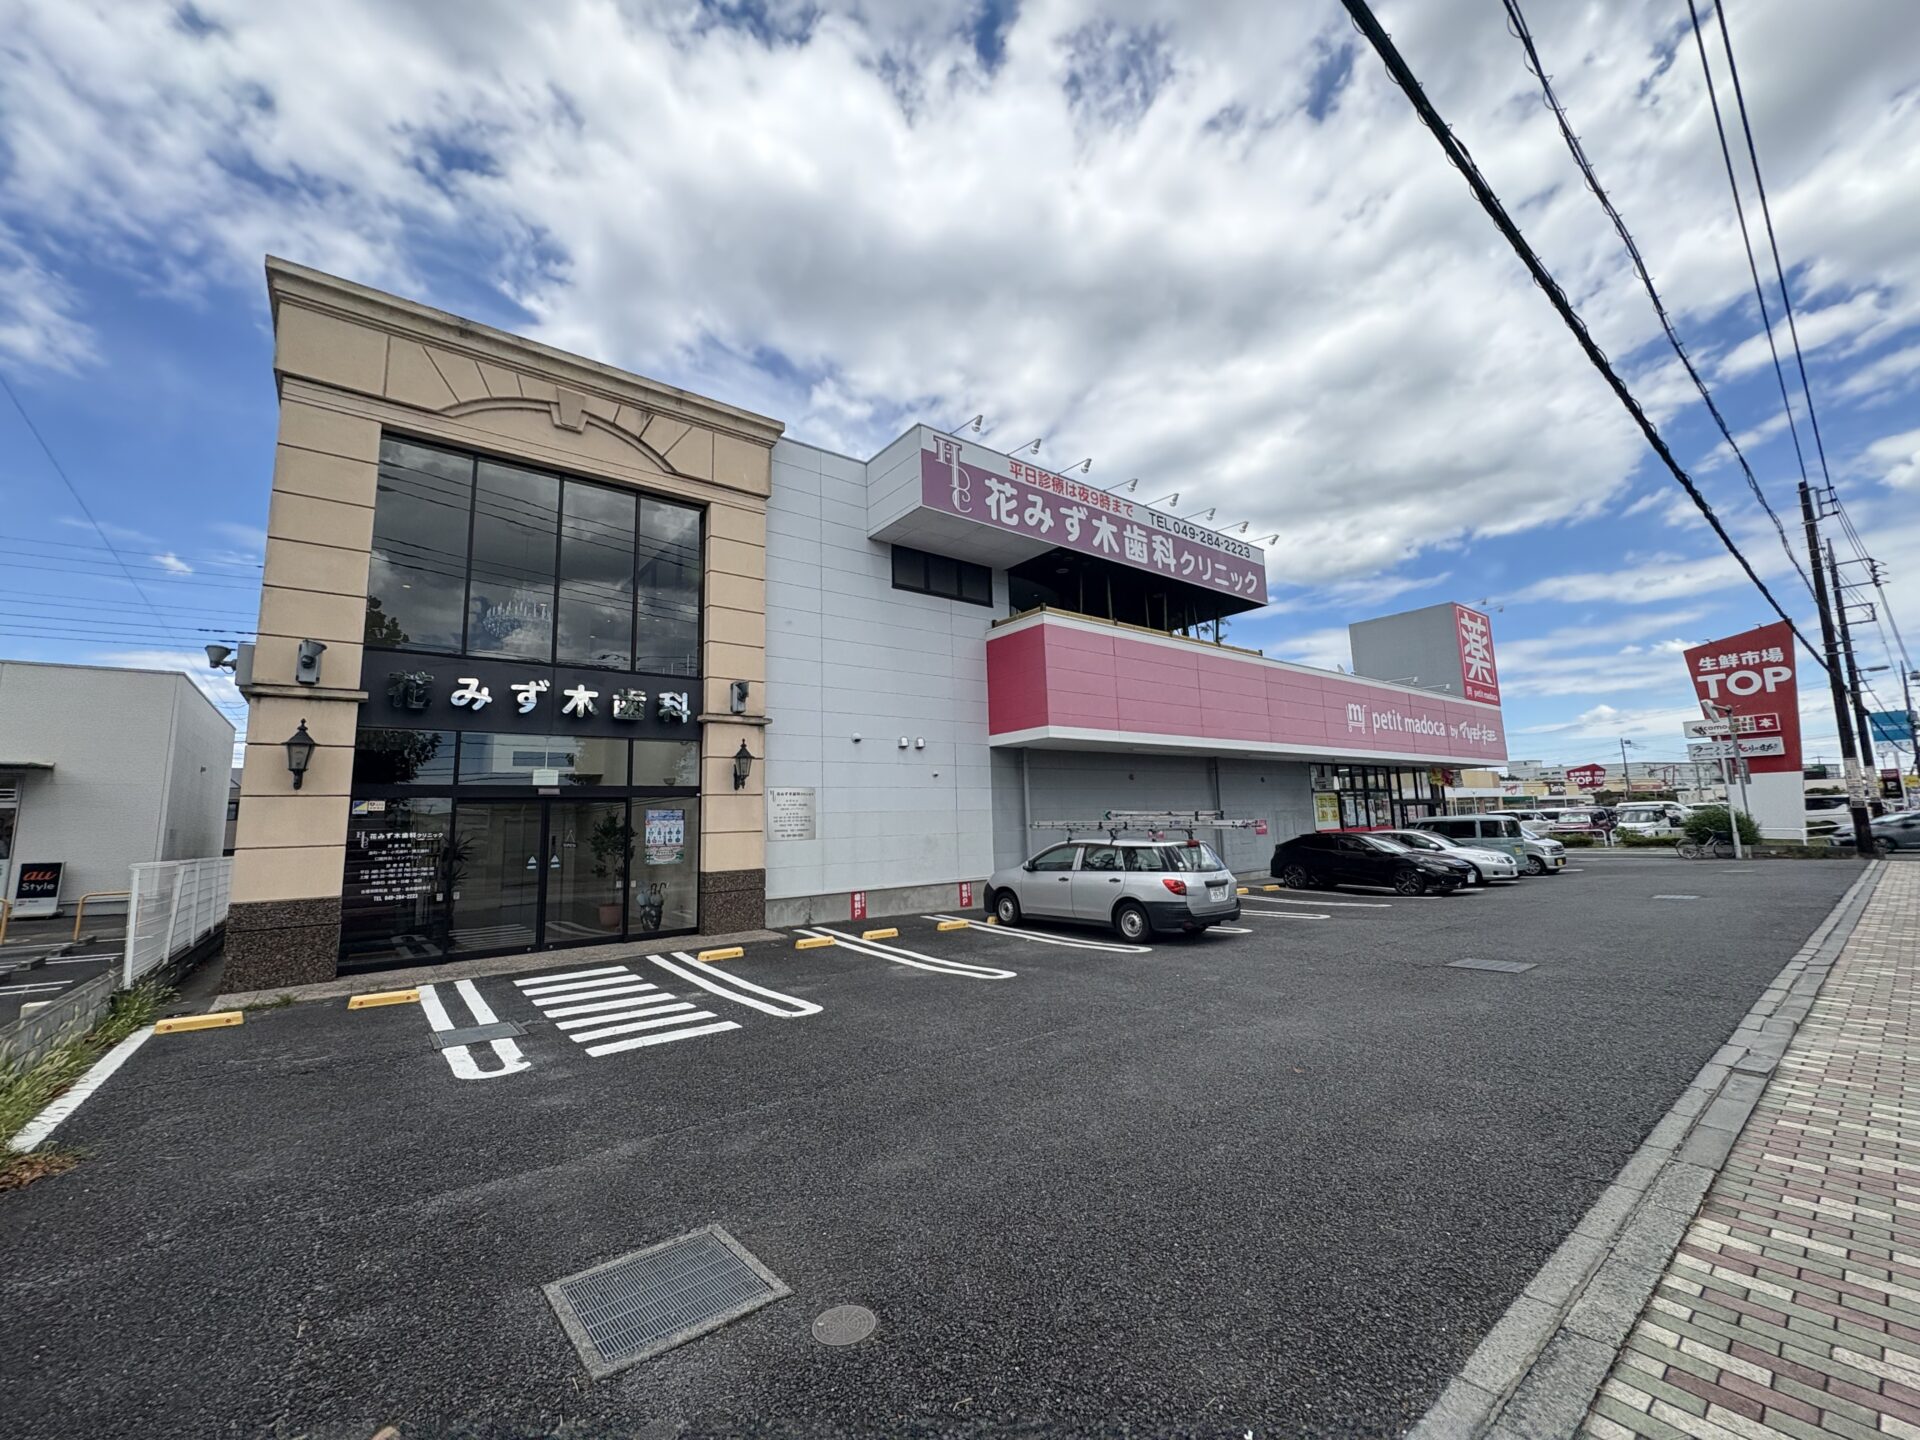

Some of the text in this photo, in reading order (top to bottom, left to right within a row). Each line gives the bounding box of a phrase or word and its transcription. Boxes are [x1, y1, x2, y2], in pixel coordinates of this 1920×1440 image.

[1009, 460, 1134, 518] 平日診療は夜9時まで
[984, 478, 1258, 595] 花みず木歯科クリニック
[1461, 612, 1493, 684] 薬
[1698, 647, 1784, 671] 生鮮市場
[1697, 666, 1792, 699] TOP
[1373, 709, 1402, 734] petit
[1405, 714, 1446, 737] madoca
[1569, 776, 1593, 785] TOP
[22, 882, 55, 892] Style
[23, 871, 57, 881] au
